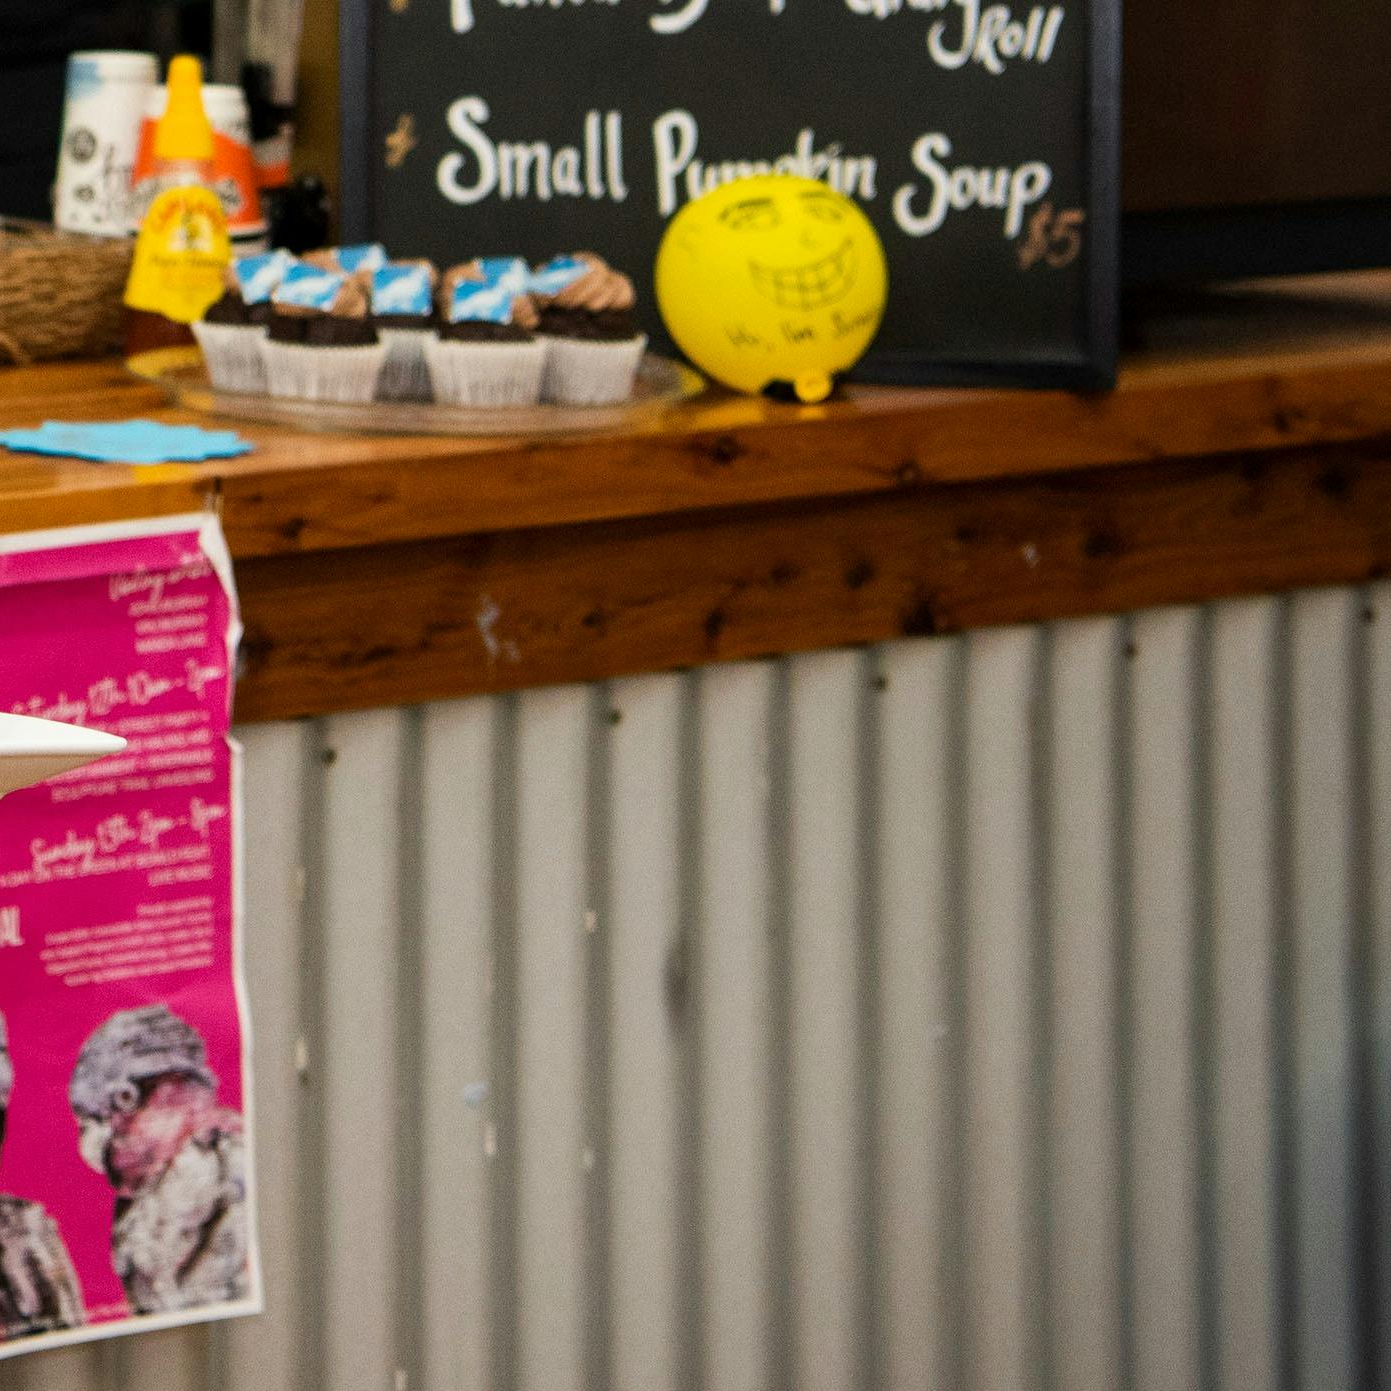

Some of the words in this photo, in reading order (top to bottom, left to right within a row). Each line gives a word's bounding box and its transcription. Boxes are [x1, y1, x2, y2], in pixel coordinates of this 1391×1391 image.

[975, 5, 1065, 74] Roll
[437, 96, 627, 205] Small
[892, 132, 1052, 238] Soup
[1018, 202, 1086, 271] $5
